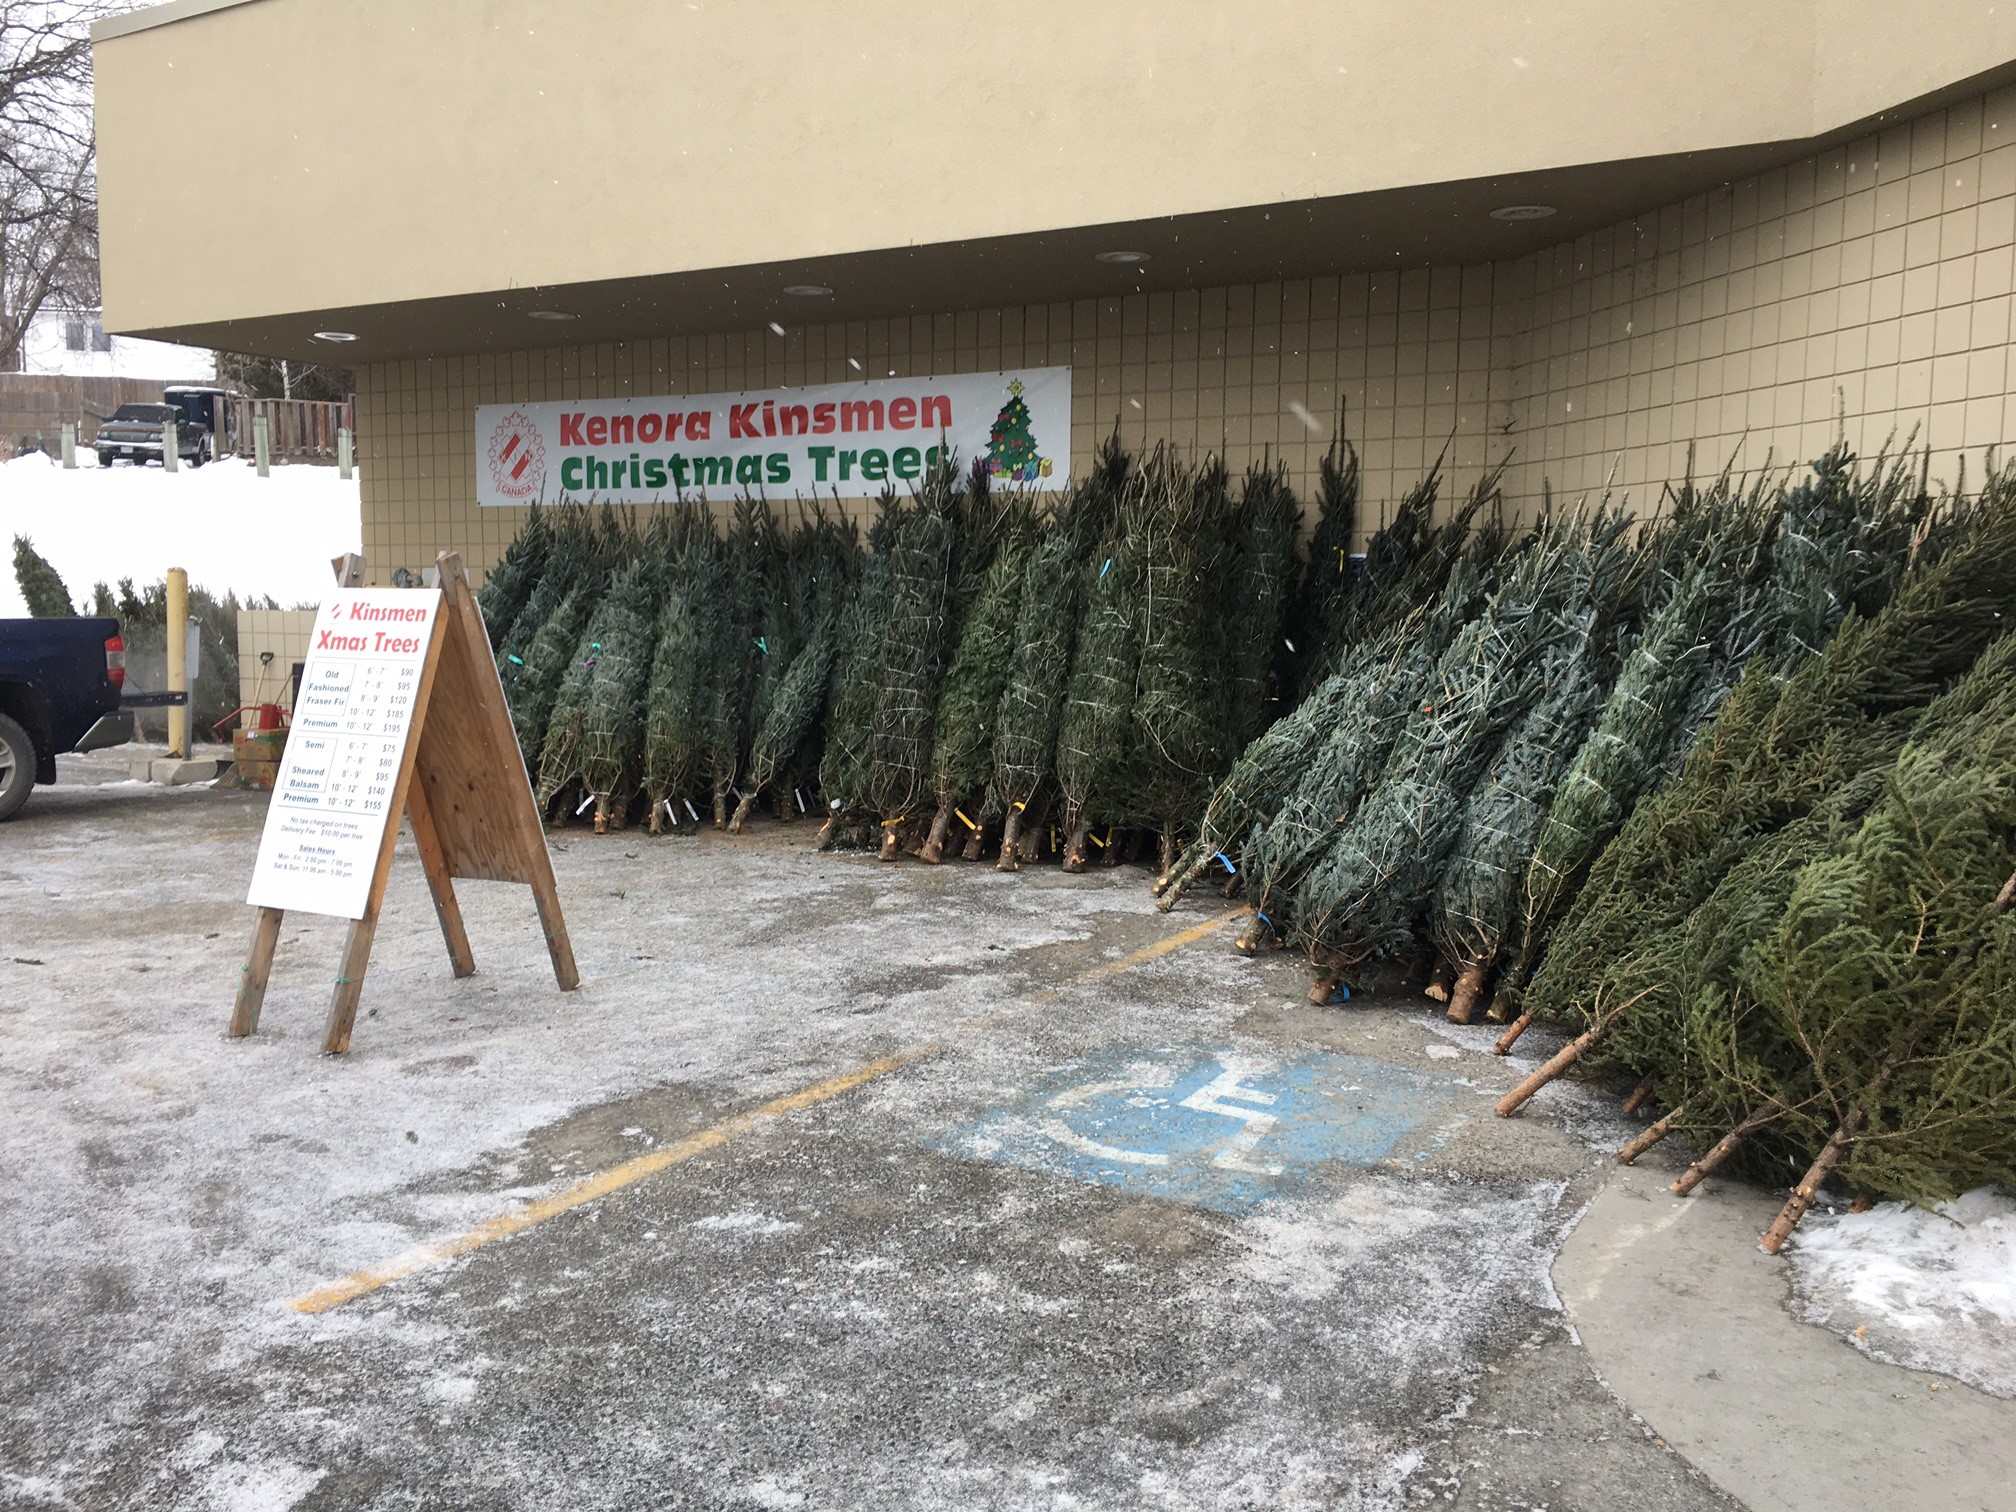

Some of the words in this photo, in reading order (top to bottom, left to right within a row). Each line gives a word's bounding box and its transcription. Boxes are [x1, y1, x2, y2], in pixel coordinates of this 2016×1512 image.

[560, 409, 711, 446] Kenora
[729, 395, 952, 439] Kinsmen
[561, 452, 791, 491] Christmas
[501, 484, 532, 496] CANADA
[350, 602, 427, 622] Kinsmen
[317, 630, 368, 651] Xmas
[374, 632, 420, 653] Trees
[325, 670, 339, 679] Old
[400, 668, 414, 677] $90
[308, 683, 349, 692] Fashioned
[397, 682, 411, 691] $95
[306, 696, 332, 705] Fraser
[334, 697, 345, 706] Fir
[390, 696, 407, 705] $120
[386, 710, 404, 719] $185
[303, 718, 338, 728] Premium
[383, 724, 401, 733] $195
[305, 740, 325, 749] Semi
[383, 744, 396, 753] $75
[379, 758, 392, 767] $80
[292, 766, 325, 776] Sheared
[376, 772, 389, 781] $95
[290, 779, 319, 789] Balsam
[368, 786, 385, 795] $140
[283, 793, 319, 803] Premium
[364, 800, 382, 810] $155
[290, 816, 299, 824] No
[309, 819, 334, 828] charged
[280, 825, 304, 835] Delivery
[299, 844, 316, 854] Sales
[317, 847, 336, 855] Hours
[317, 858, 326, 866] pm
